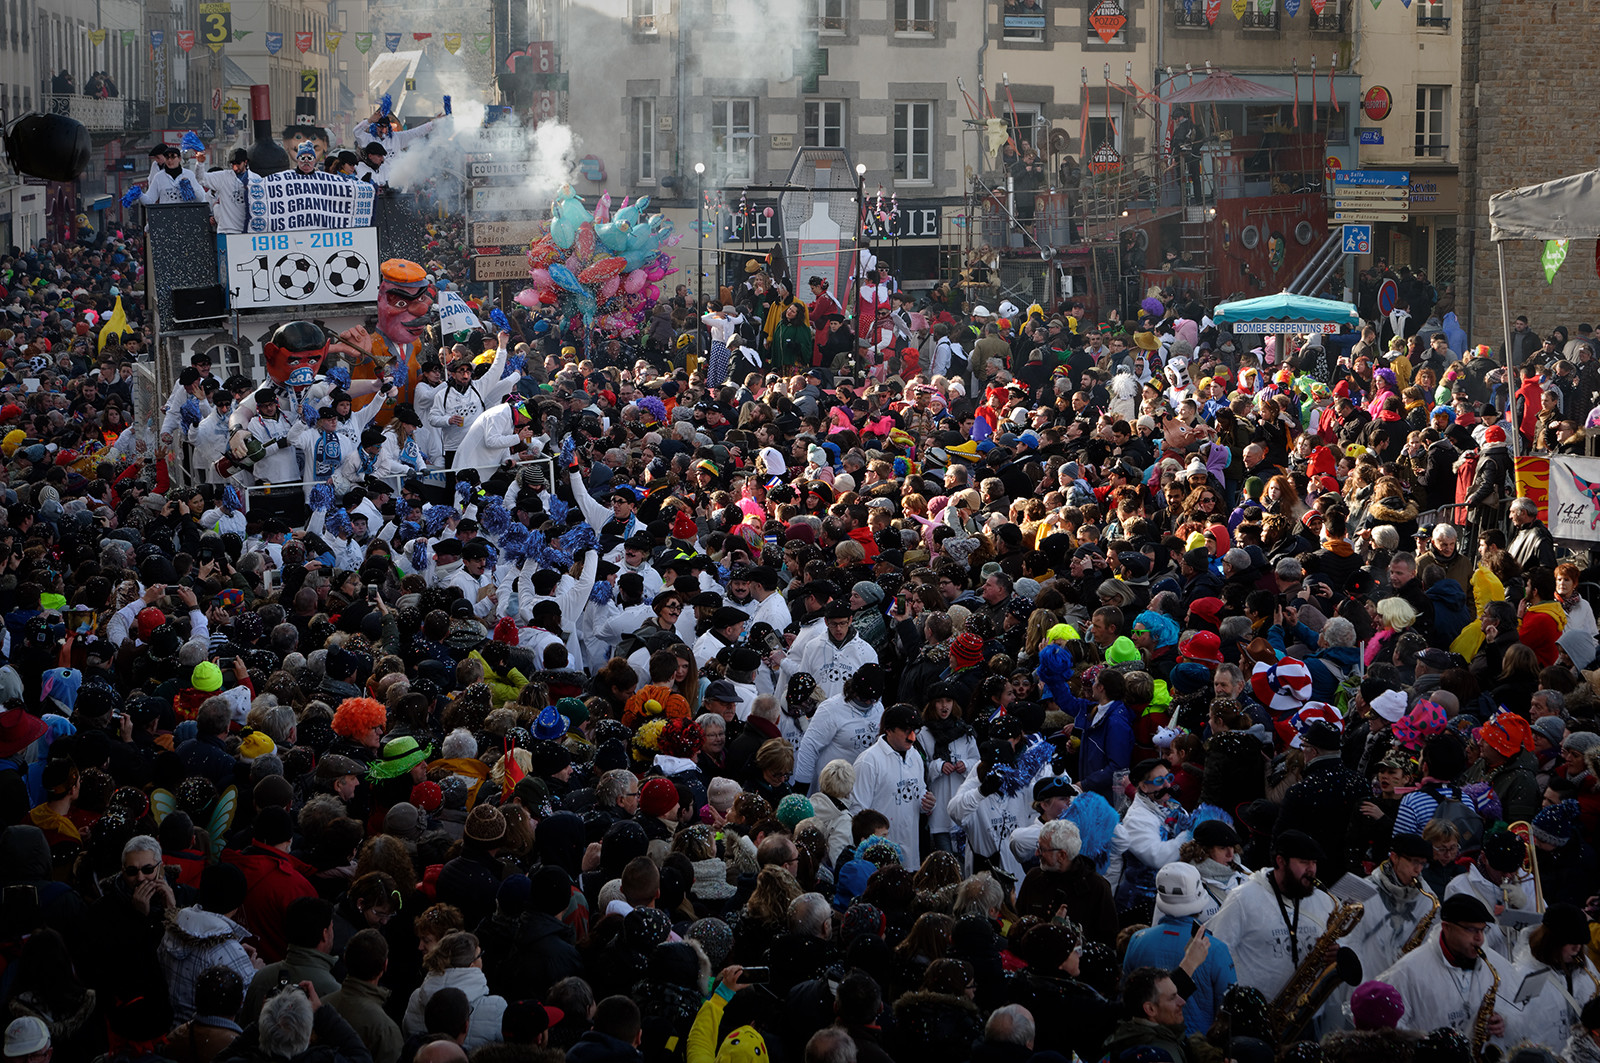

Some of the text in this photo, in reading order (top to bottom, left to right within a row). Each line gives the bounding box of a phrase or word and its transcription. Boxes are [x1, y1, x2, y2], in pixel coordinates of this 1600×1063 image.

[1094, 17, 1120, 26] POZZO
[206, 13, 228, 42] 3
[303, 75, 316, 92] 2
[407, 79, 415, 90] 1
[474, 163, 528, 174] COUTANCES
[267, 173, 282, 182] US
[268, 182, 353, 198] US GRANVILLE
[269, 197, 351, 215] US GRANVILLE
[270, 213, 350, 232] US GRANVILLE
[354, 217, 369, 225] 1918
[728, 208, 938, 240] PHACIE
[251, 235, 289, 251] 1918
[310, 232, 353, 248] 2018
[476, 235, 505, 243] Casino
[478, 260, 491, 268] Les
[477, 270, 533, 279] Commissaria
[1236, 323, 1267, 333] BOMBE
[1269, 323, 1322, 333] SERPENTINS
